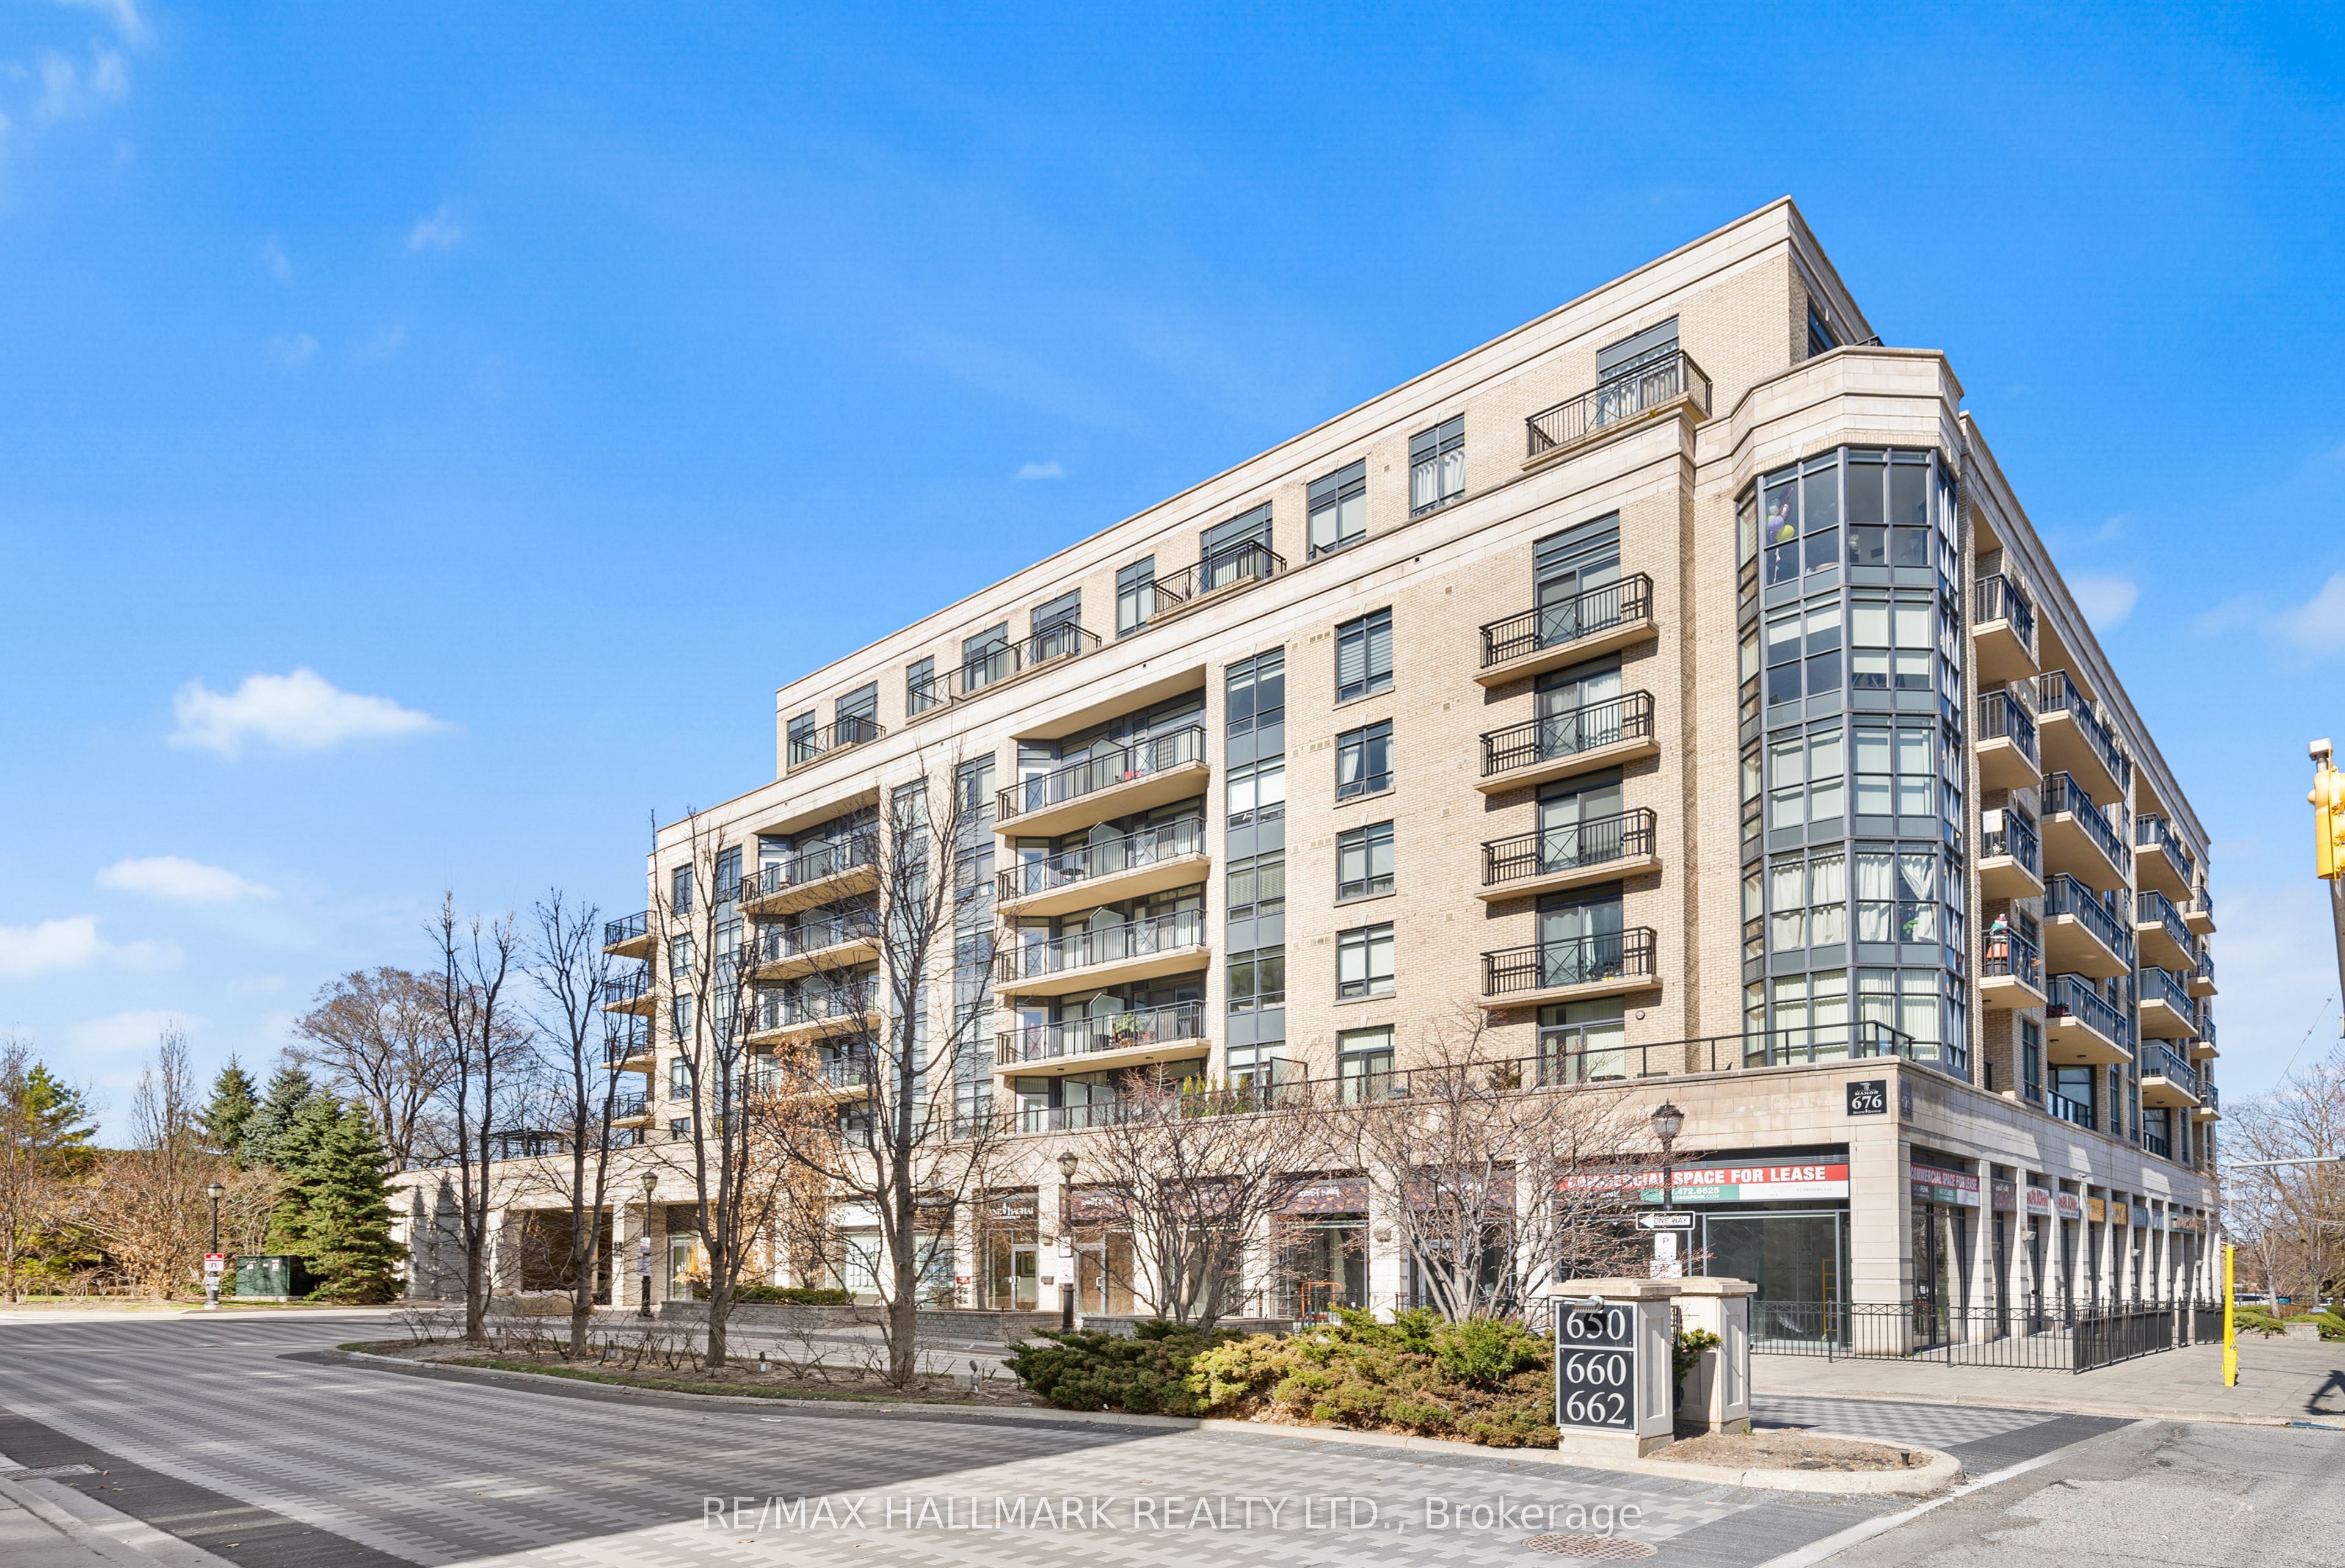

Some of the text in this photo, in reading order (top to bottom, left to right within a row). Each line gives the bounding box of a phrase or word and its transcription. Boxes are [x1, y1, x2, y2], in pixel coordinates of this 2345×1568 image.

[1852, 1094, 1882, 1109] 676
[1673, 1170, 1725, 1185] SPACE
[1731, 1169, 1764, 1183] FOR
[1770, 1167, 1826, 1181] LEASE
[1911, 1167, 1977, 1191] COMMERCIAL SPACE FOR LEASE
[1566, 1309, 1626, 1340] 650
[1566, 1352, 1626, 1386] 660
[1566, 1390, 1627, 1425] 662
